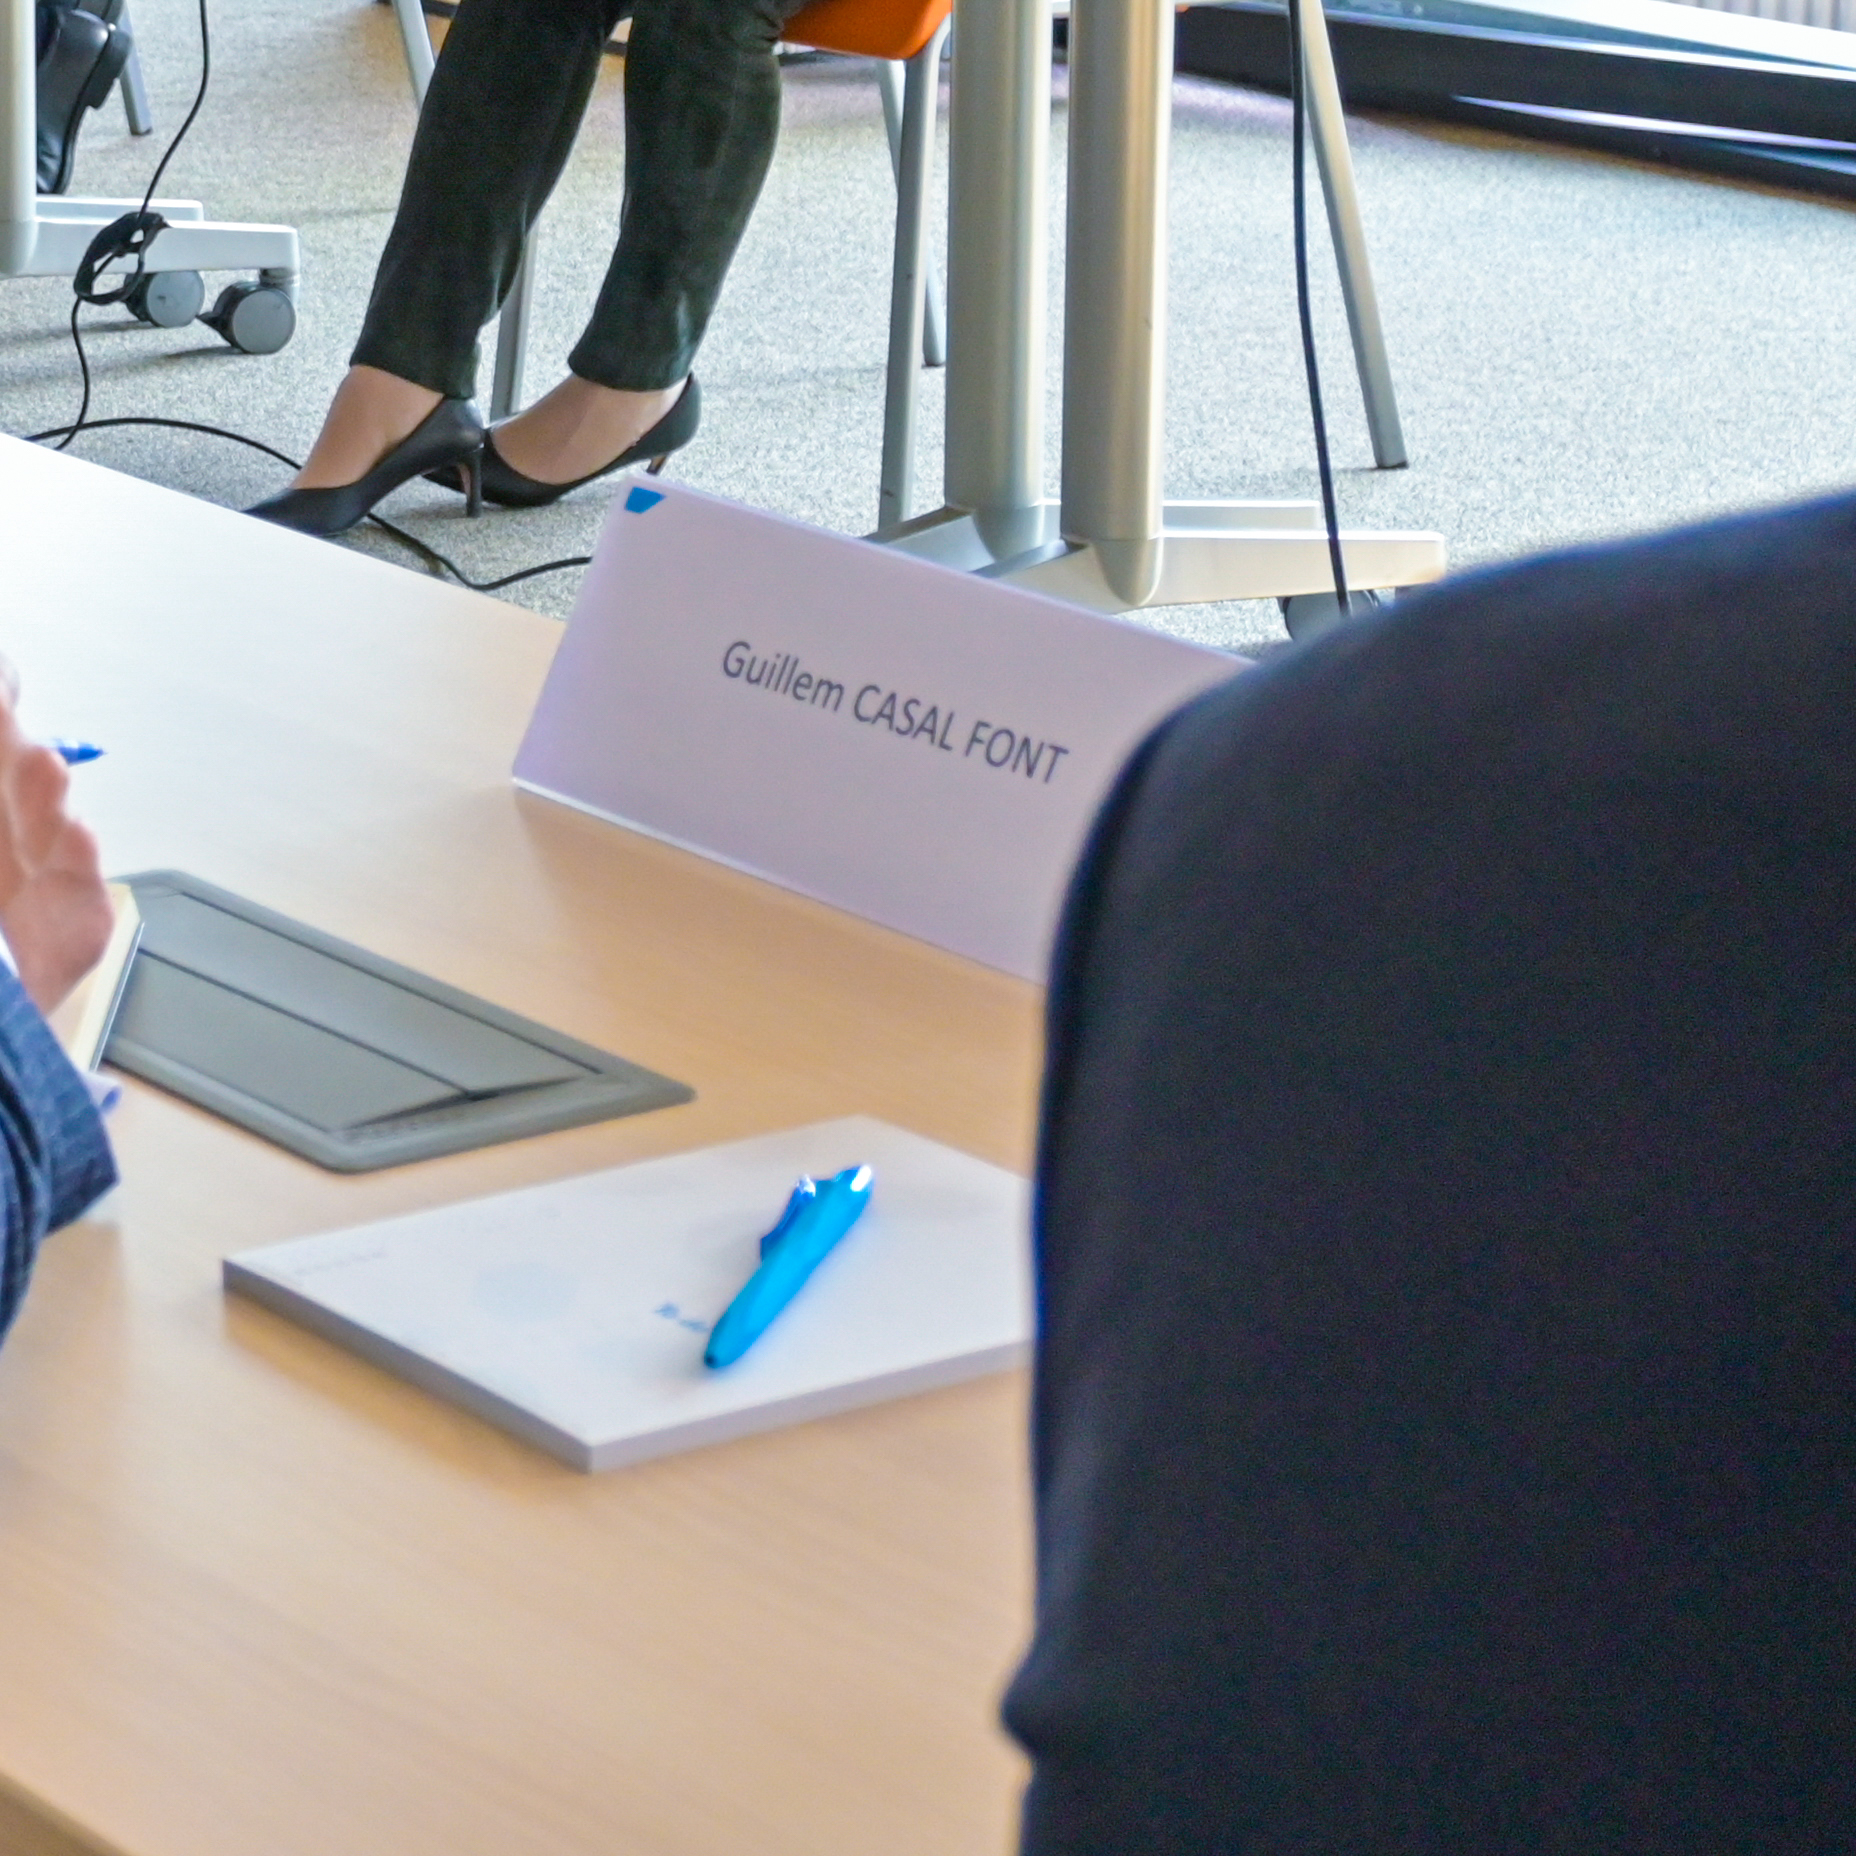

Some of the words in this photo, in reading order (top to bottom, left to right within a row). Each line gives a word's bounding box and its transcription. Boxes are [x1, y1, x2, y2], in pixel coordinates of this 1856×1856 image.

[722, 641, 845, 712] Guillem
[853, 684, 955, 751] CASAL
[965, 721, 1070, 784] FONT
